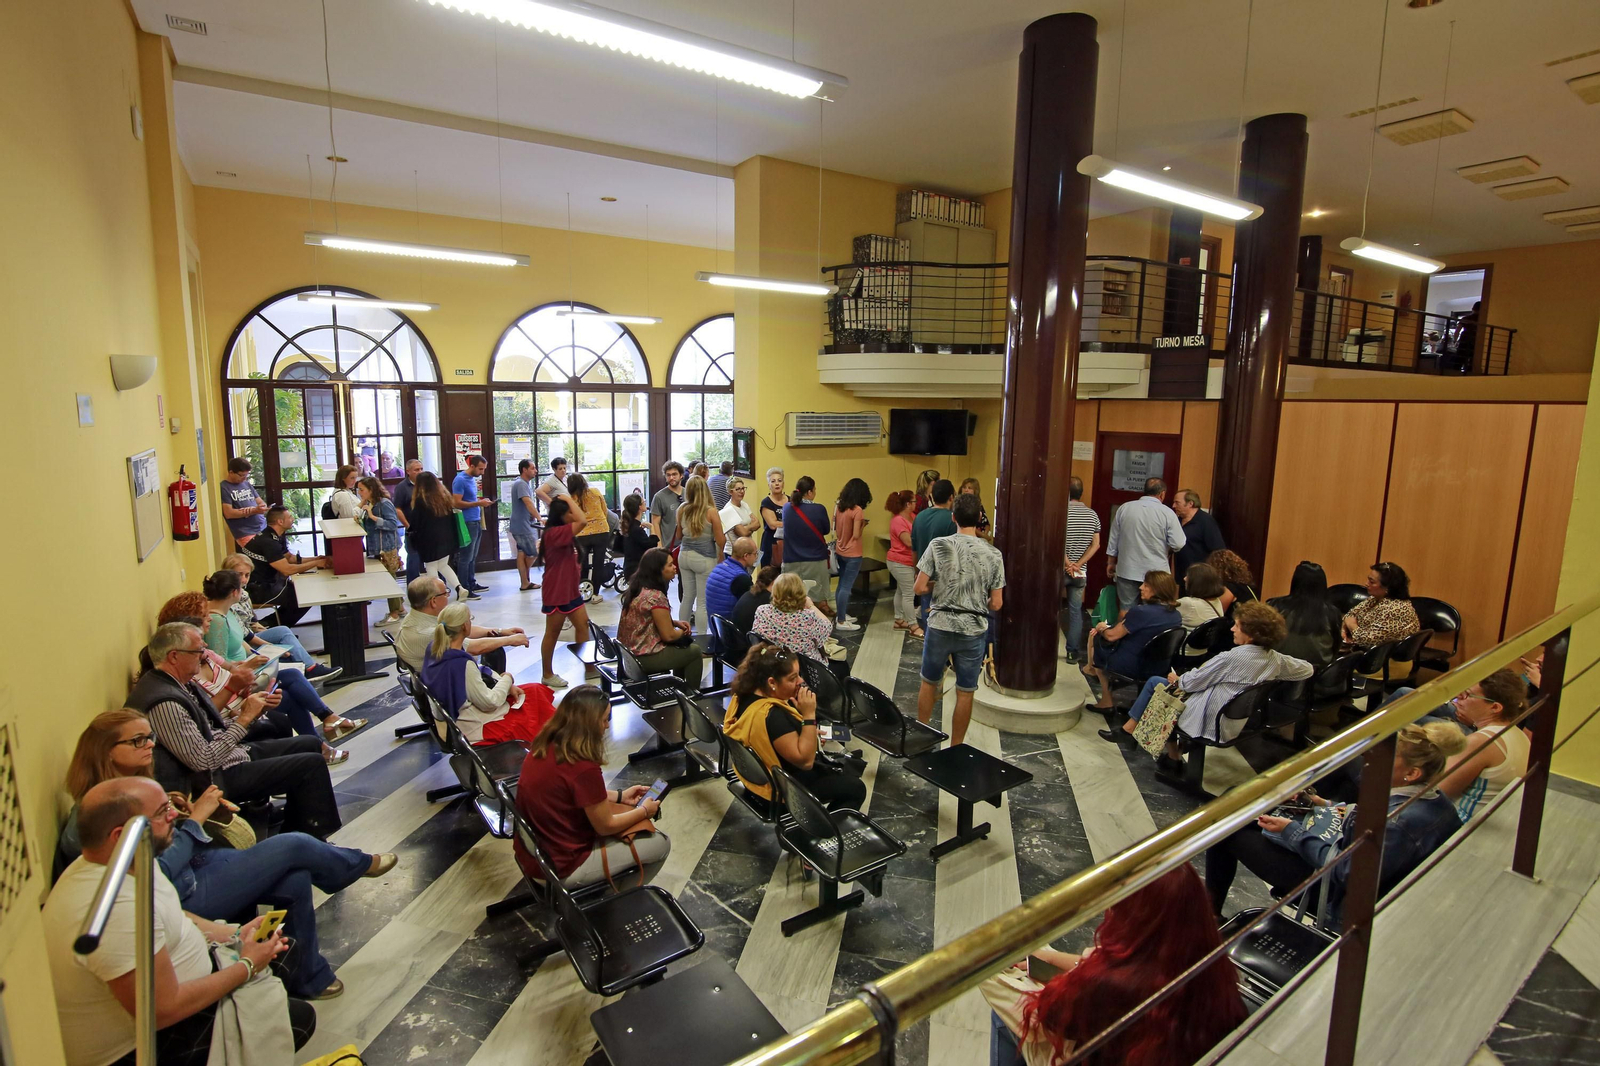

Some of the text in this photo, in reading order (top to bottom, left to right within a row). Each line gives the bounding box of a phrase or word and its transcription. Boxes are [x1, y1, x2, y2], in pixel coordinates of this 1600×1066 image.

[1155, 335, 1205, 348] TURNO MESA
[1319, 806, 1342, 842] MPORTA
